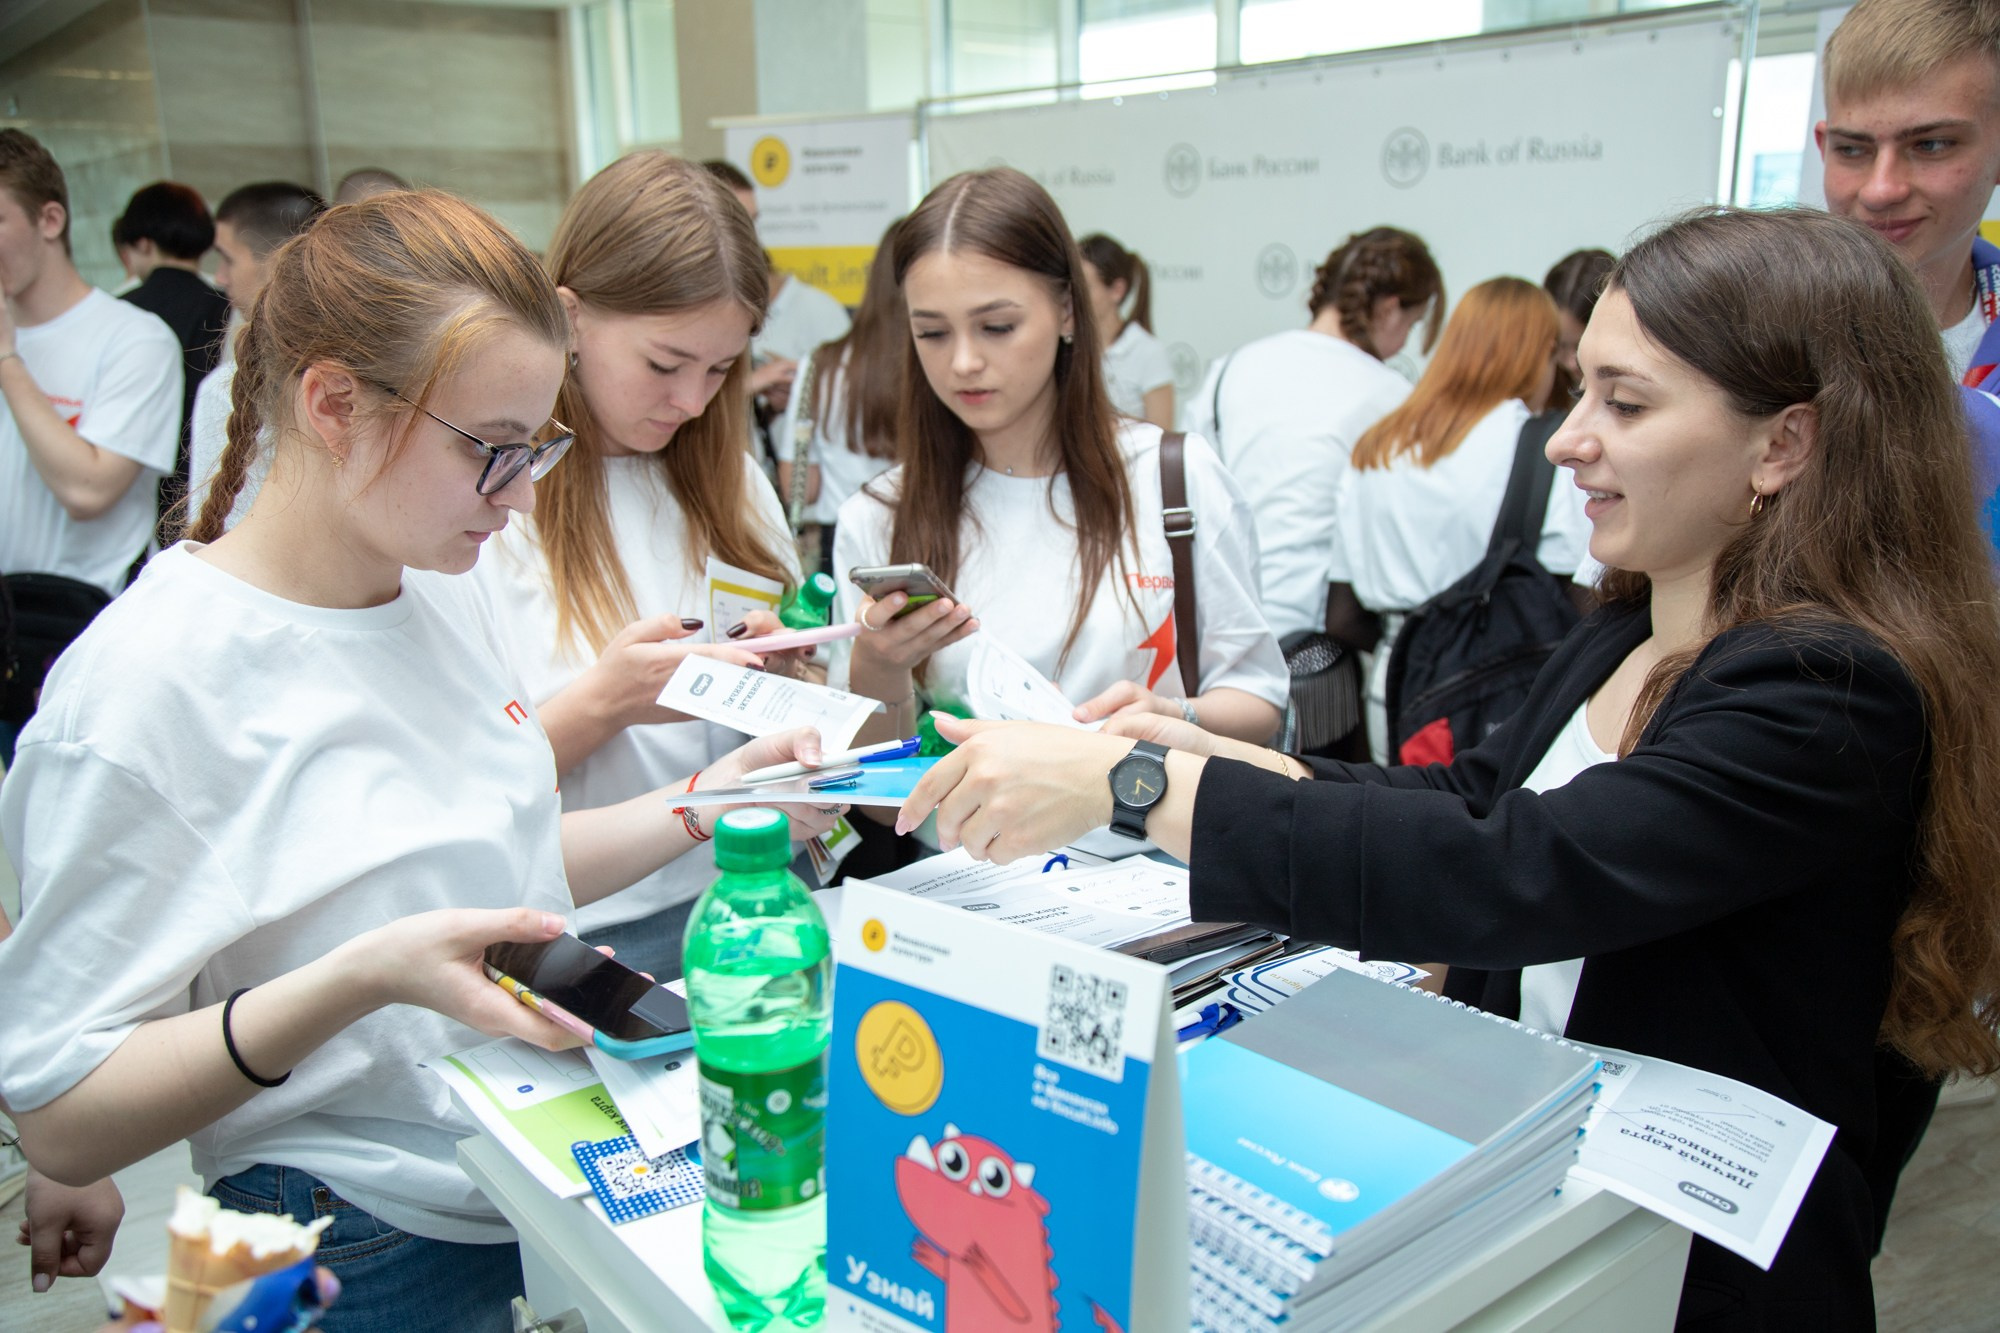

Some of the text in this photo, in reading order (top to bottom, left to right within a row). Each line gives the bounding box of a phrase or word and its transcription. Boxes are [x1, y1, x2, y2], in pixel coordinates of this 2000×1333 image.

[1437, 133, 1603, 170] Bank of Russia
[1208, 155, 1321, 181] Банк России
[722, 680, 747, 708] Личная
[738, 675, 767, 711] активност
[998, 912, 1034, 922] ичная
[590, 1096, 620, 1120] карта
[1619, 1127, 1755, 1190] Личная карта
[1643, 1124, 1759, 1179] активности
[1682, 1183, 1733, 1211] Старт!
[845, 1254, 935, 1322] Узнай
